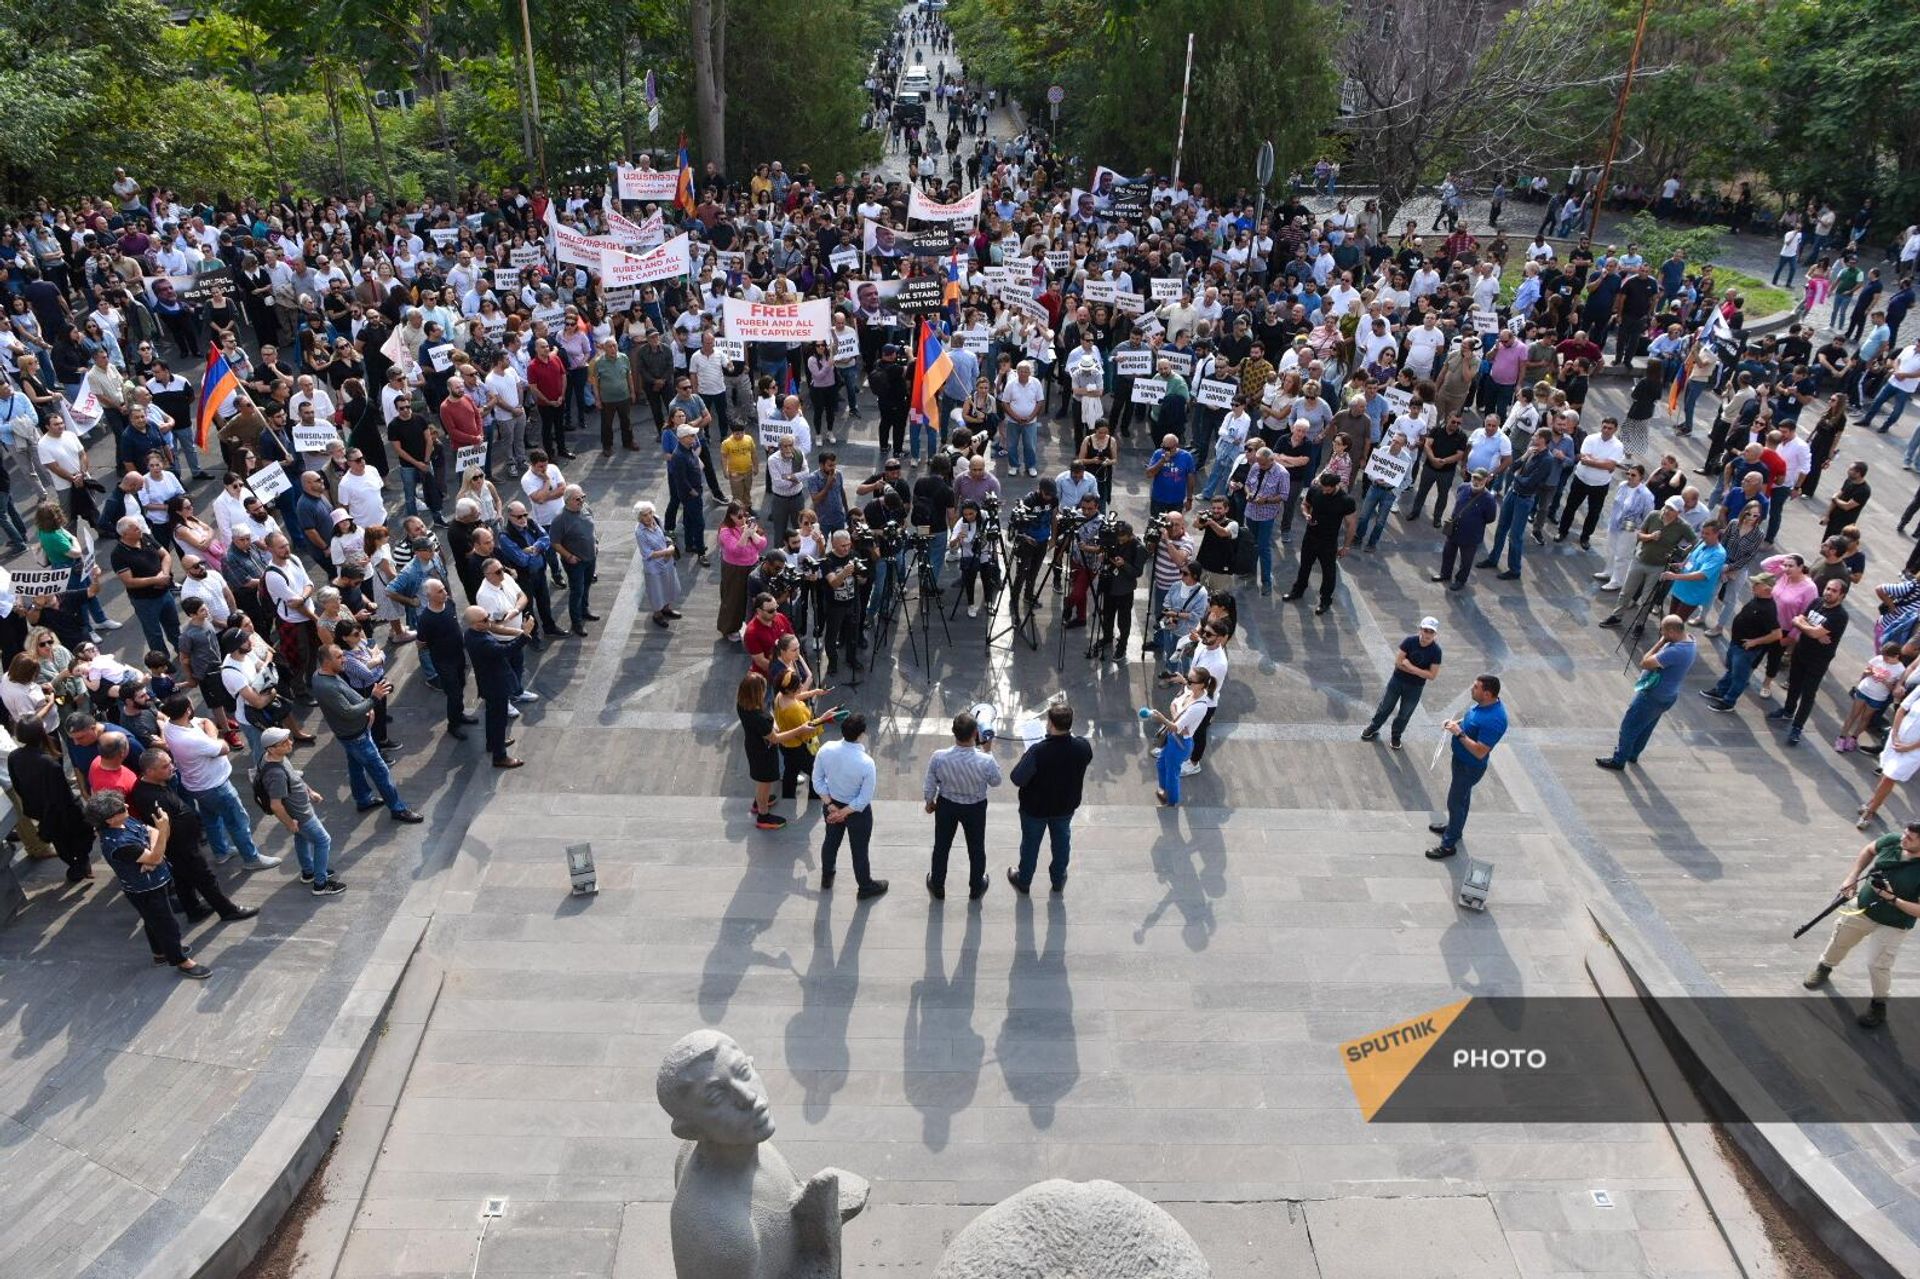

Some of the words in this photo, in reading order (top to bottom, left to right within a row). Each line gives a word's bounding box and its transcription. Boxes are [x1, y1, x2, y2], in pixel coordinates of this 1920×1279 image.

[921, 238, 949, 247] ТОБОЙ
[612, 265, 643, 273] RUBEN
[645, 261, 664, 270] AND
[665, 256, 681, 264] ALL
[617, 274, 635, 283] THE
[636, 264, 680, 280] CAPTIVES!
[908, 281, 940, 290] RUBEN,
[913, 290, 940, 299] STAND
[899, 301, 922, 309] WITH
[750, 303, 799, 318] FREE
[736, 318, 769, 327] RUBEN
[772, 319, 793, 327] AND
[795, 319, 815, 327] ALL
[740, 328, 759, 337] THE
[761, 329, 812, 337] CAPTIVES!
[11, 571, 69, 583] ՄԱՄՅԱՆ
[15, 585, 61, 596] ՏԱՐՈՆ
